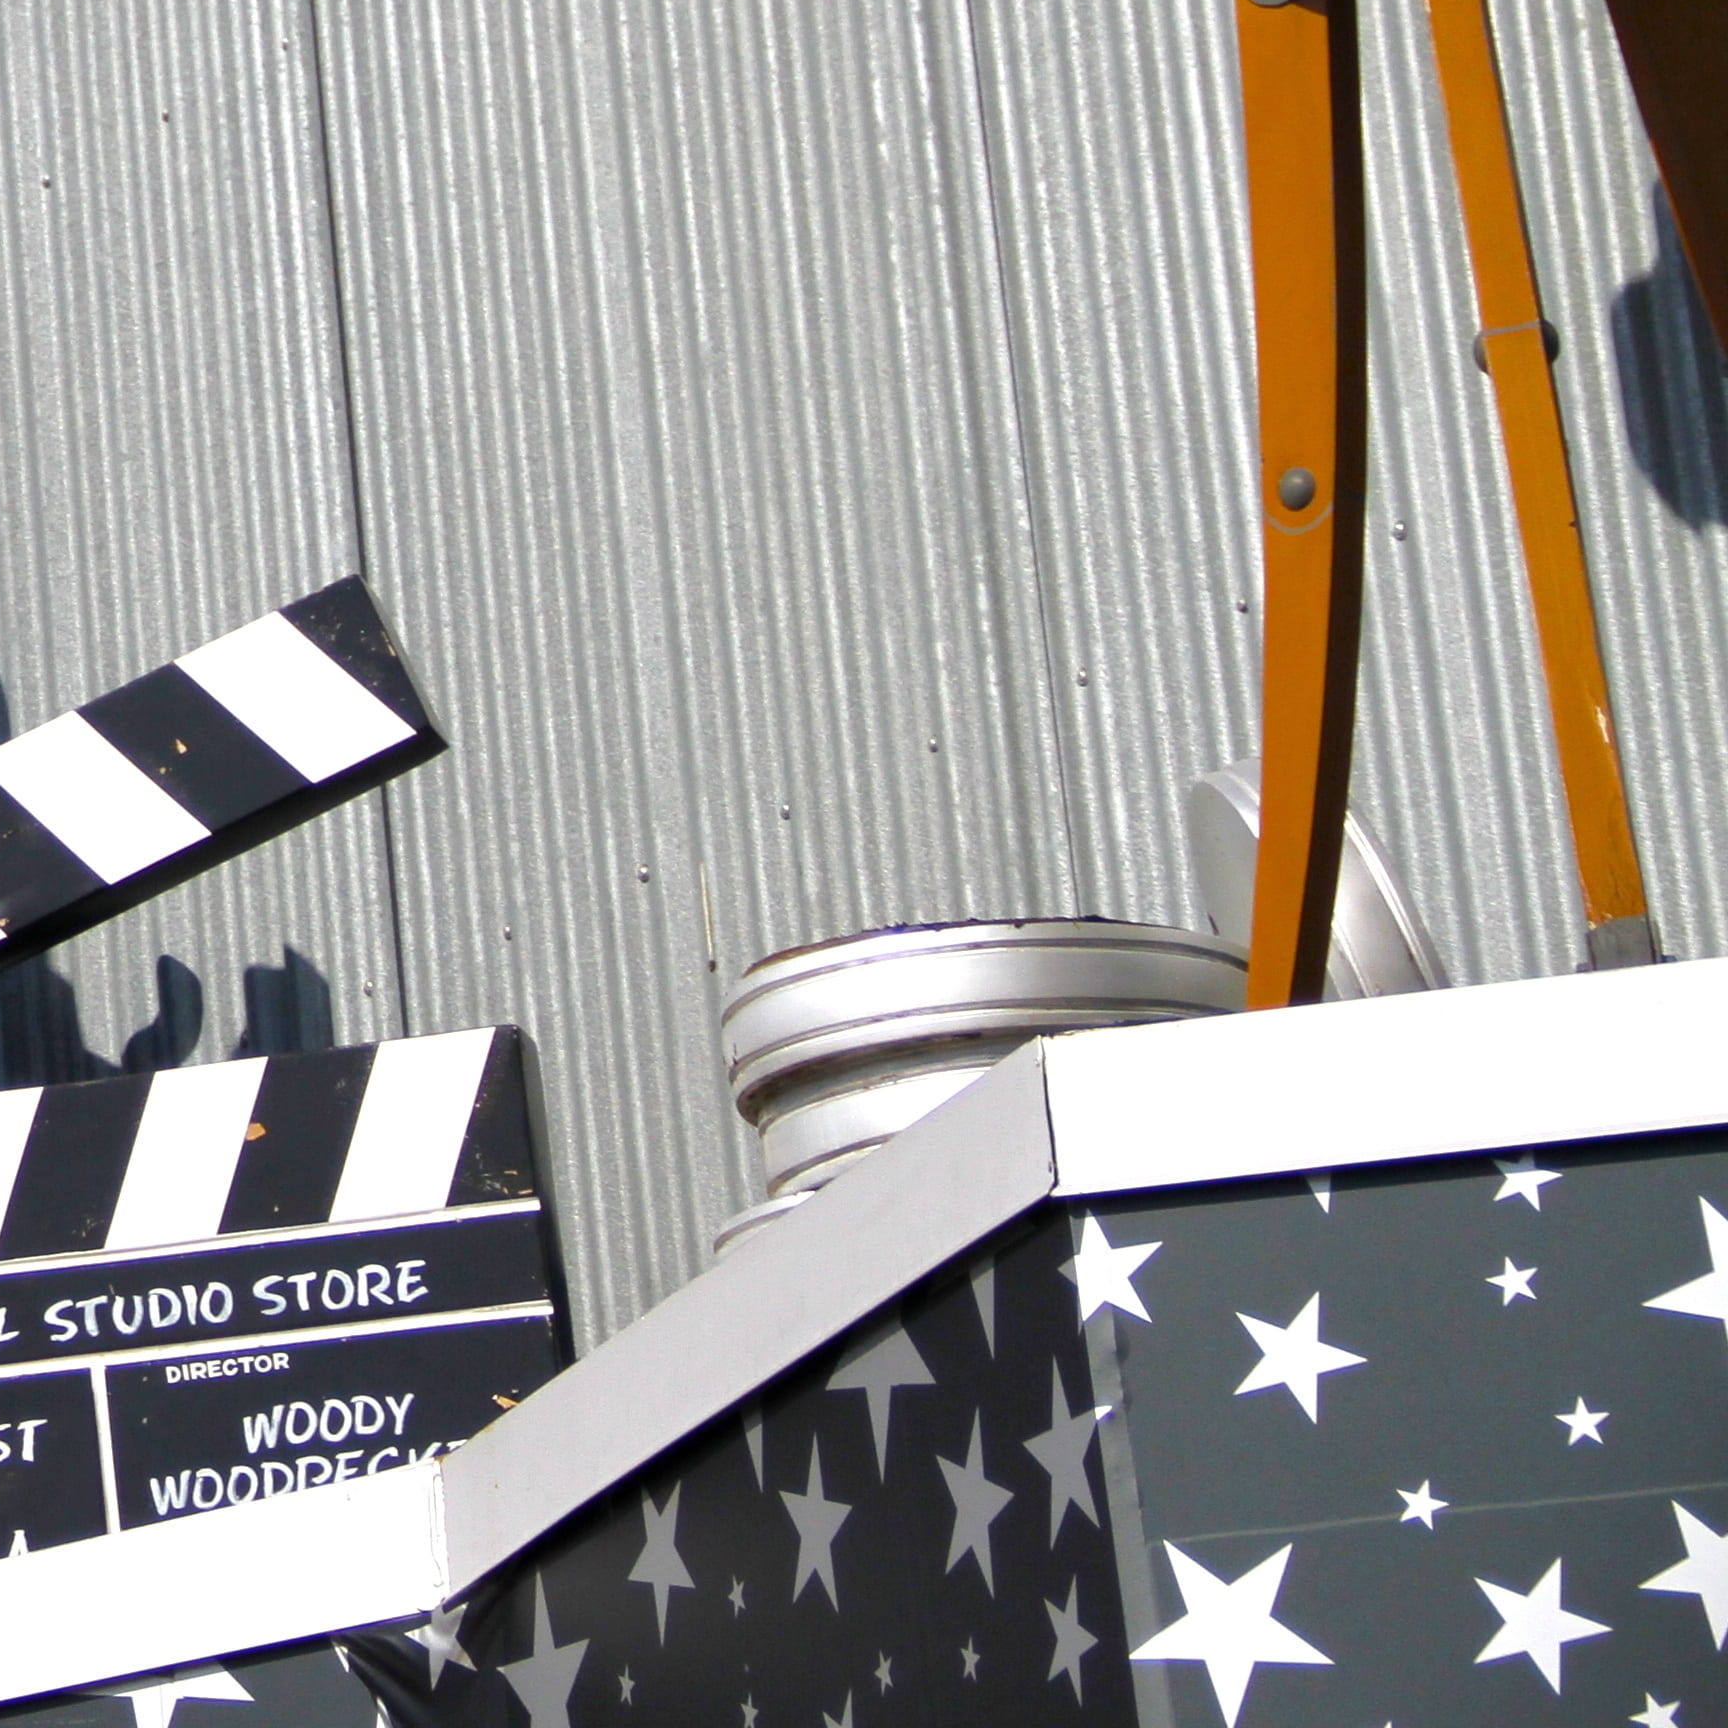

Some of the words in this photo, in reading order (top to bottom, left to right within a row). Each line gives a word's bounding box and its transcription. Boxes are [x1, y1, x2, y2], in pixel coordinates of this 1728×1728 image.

[44, 1282, 233, 1341] STUDIO
[253, 1260, 428, 1315] STORE
[166, 1353, 289, 1383] DIRECTOR
[243, 1393, 414, 1453] WOODY
[150, 1439, 469, 1515] WOODPEC
